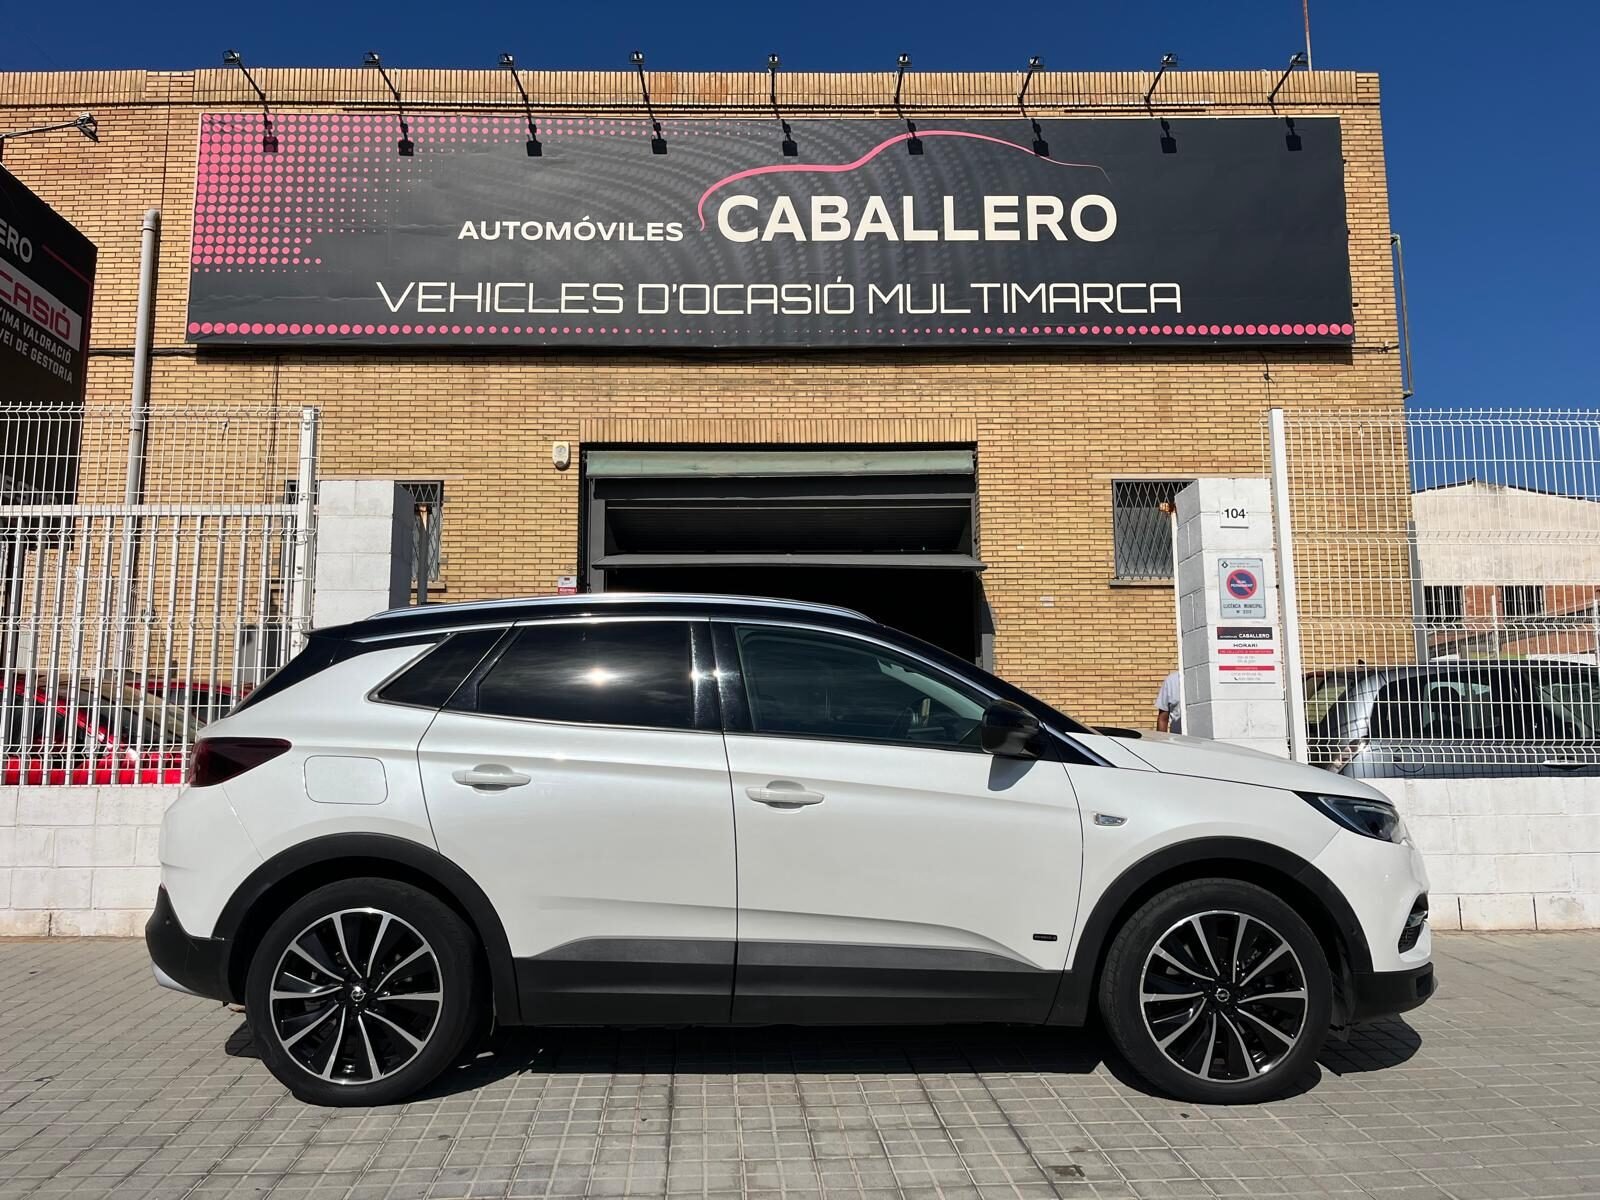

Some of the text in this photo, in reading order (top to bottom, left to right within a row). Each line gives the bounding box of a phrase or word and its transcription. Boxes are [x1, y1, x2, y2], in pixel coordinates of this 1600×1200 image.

[458, 194, 1118, 242] AUTOMÓVILES CABALLERO
[376, 275, 1182, 315] VEHICLES D'OCASIÓ MULTIMARCA
[15, 338, 29, 356] DE
[30, 347, 73, 384] GESTORIA
[23, 322, 72, 364] VALORACIÓ
[1223, 508, 1246, 519] 104
